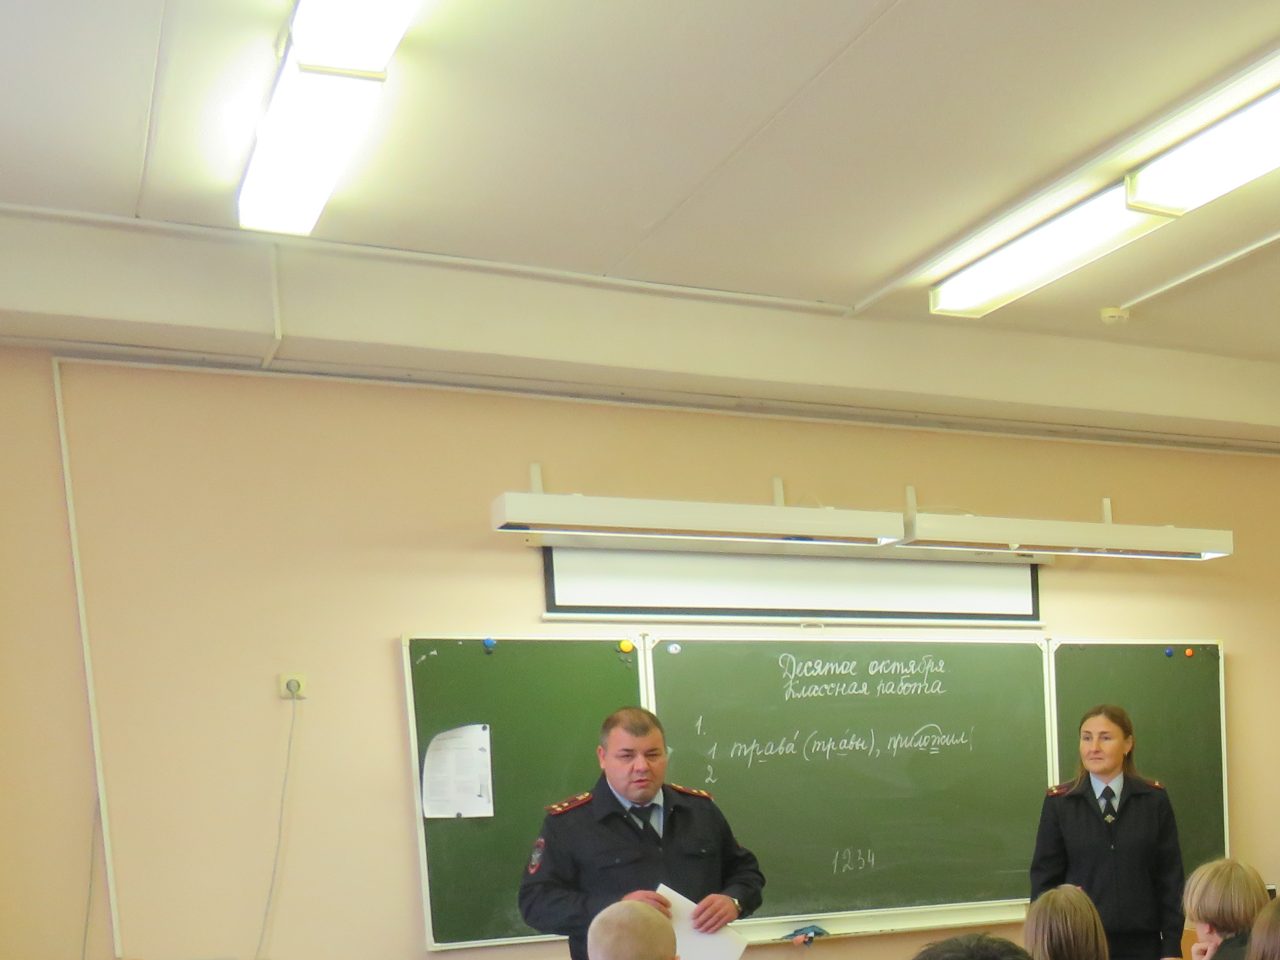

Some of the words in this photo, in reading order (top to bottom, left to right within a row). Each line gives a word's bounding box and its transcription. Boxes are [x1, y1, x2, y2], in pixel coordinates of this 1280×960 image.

[778, 652, 858, 680] Десятое
[868, 654, 946, 684] октября
[784, 679, 871, 701] Классная
[876, 675, 947, 697] работа
[704, 764, 719, 784] 2
[832, 848, 876, 875] 1234
